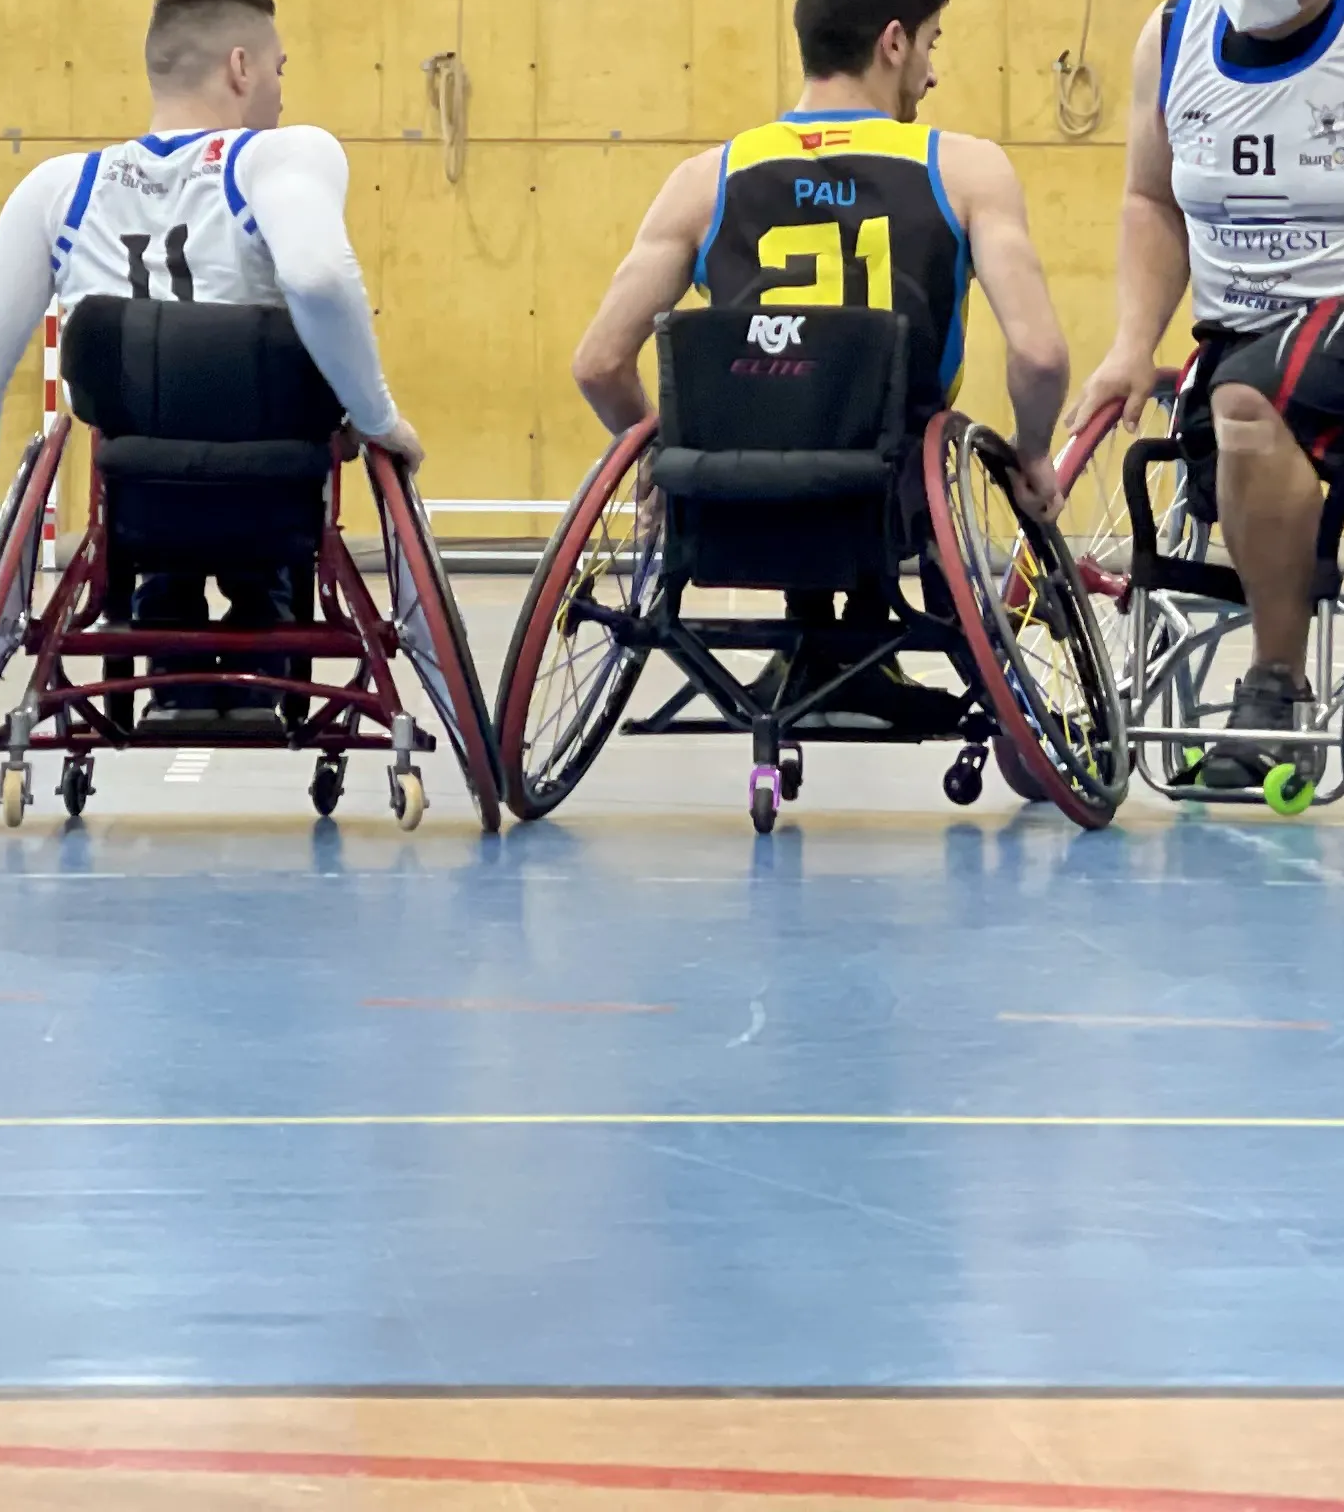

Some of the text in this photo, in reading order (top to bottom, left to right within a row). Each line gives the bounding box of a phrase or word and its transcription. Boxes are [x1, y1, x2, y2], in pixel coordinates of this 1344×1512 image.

[1233, 133, 1276, 176] 61
[794, 178, 856, 208] PAU
[120, 223, 194, 301] 11
[758, 215, 893, 312] 21
[746, 314, 806, 354] RGK
[730, 358, 820, 375] ELITE
